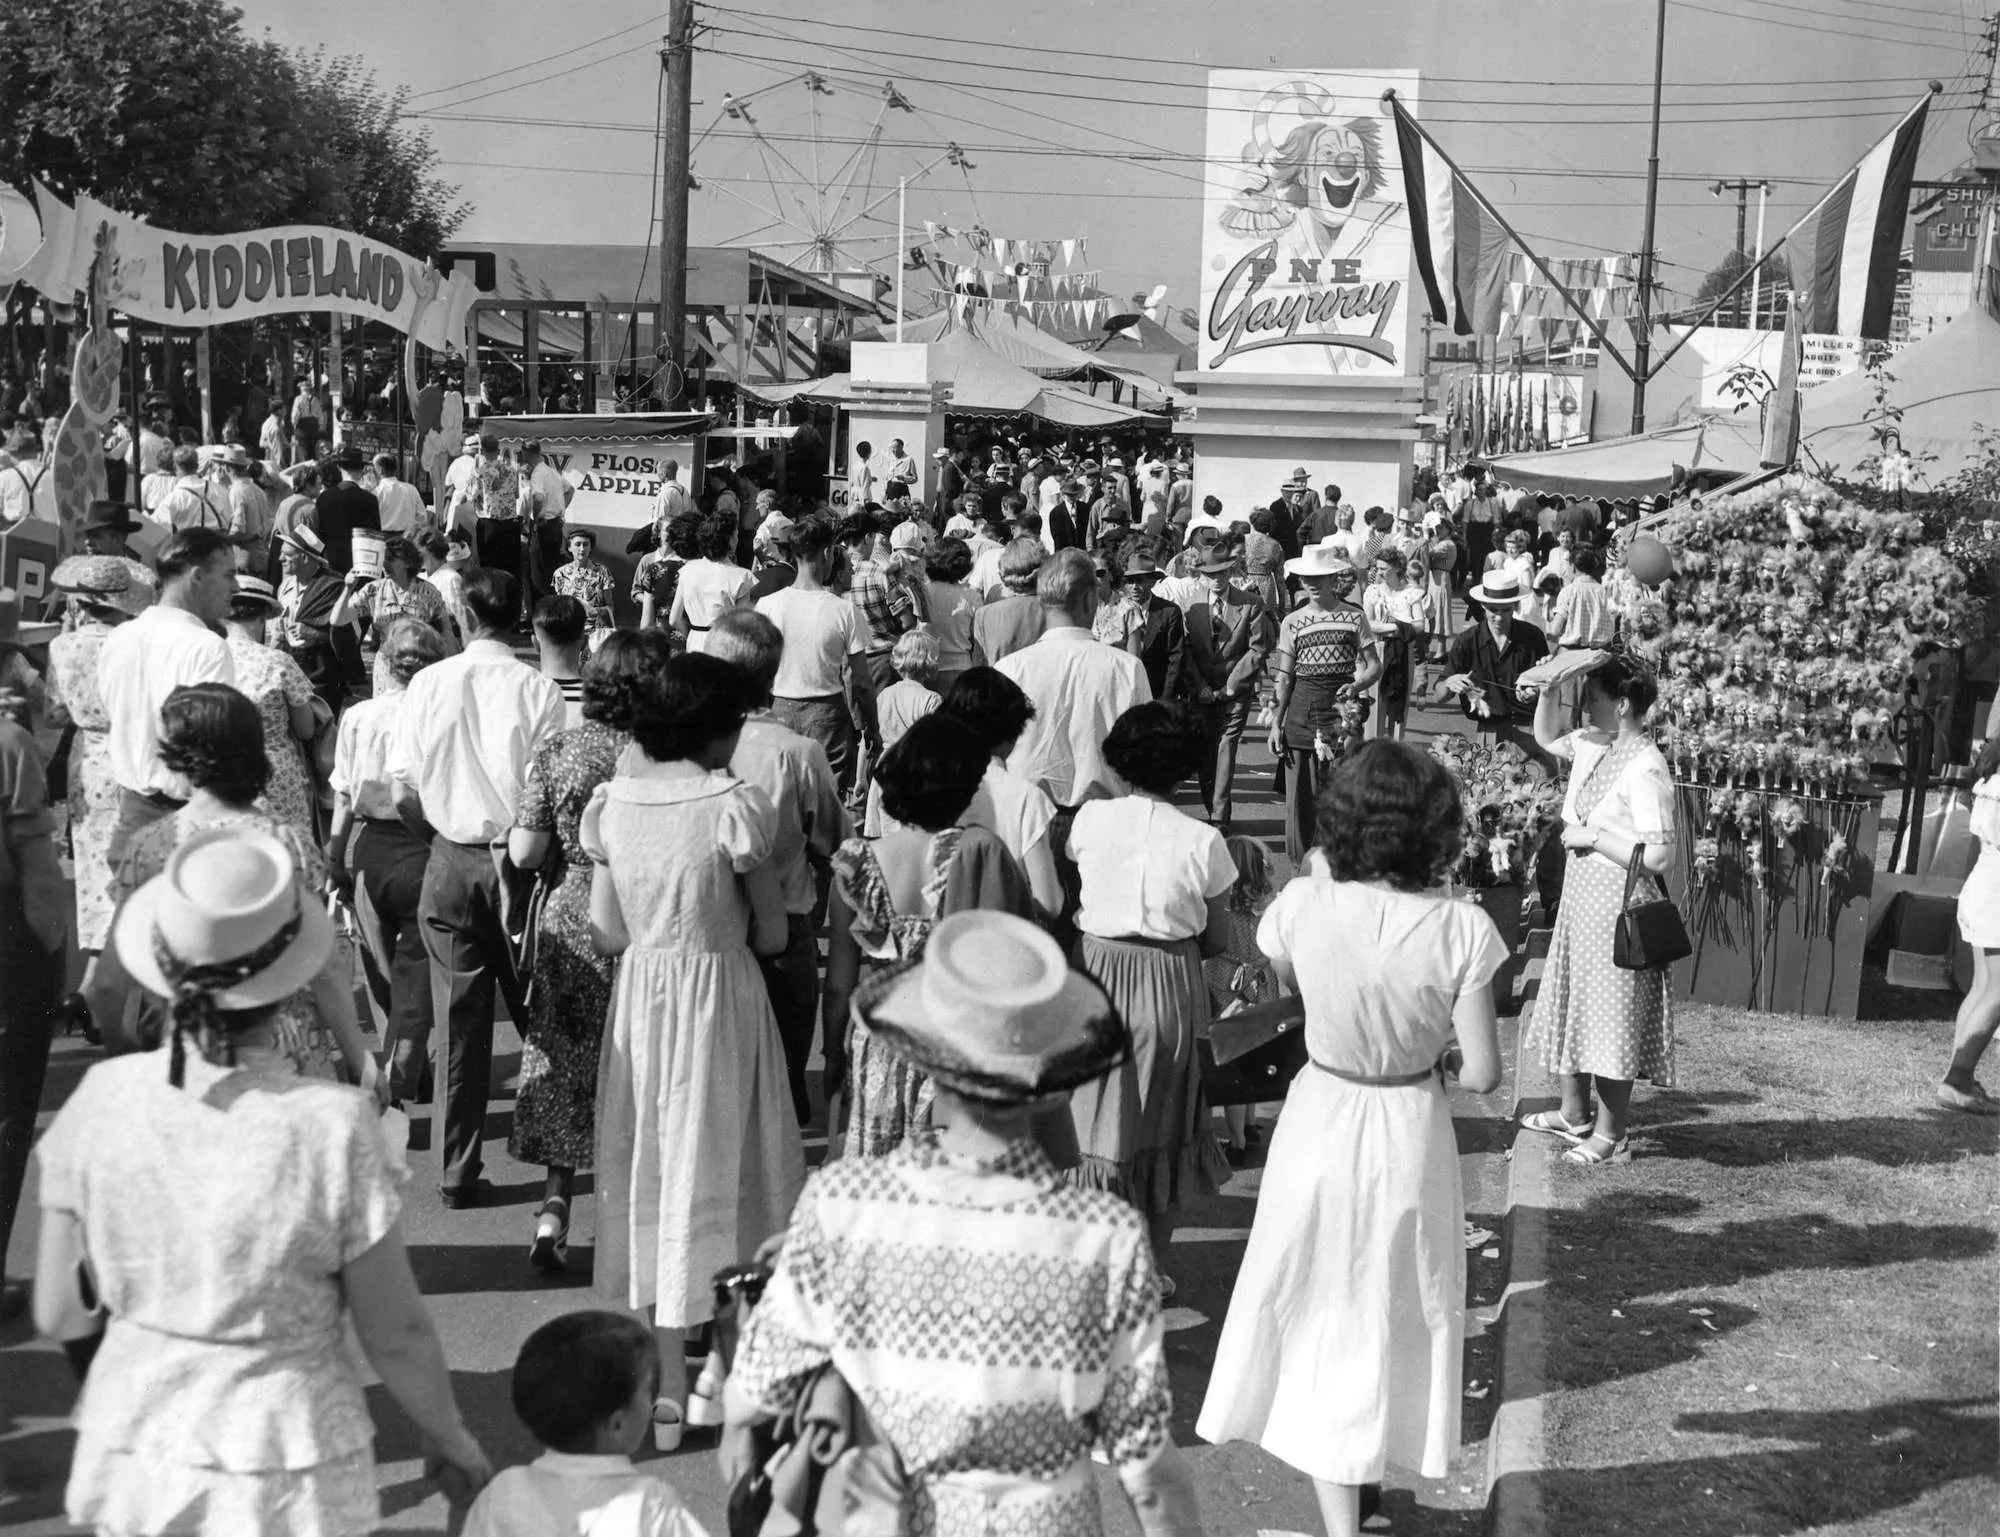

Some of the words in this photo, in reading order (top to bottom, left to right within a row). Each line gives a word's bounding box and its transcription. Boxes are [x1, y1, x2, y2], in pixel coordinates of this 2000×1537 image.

[163, 236, 404, 314] KIDDIELAND
[1208, 239, 1401, 370] Gayway
[1806, 340, 1854, 349] MILLER
[591, 452, 661, 474] FLOS
